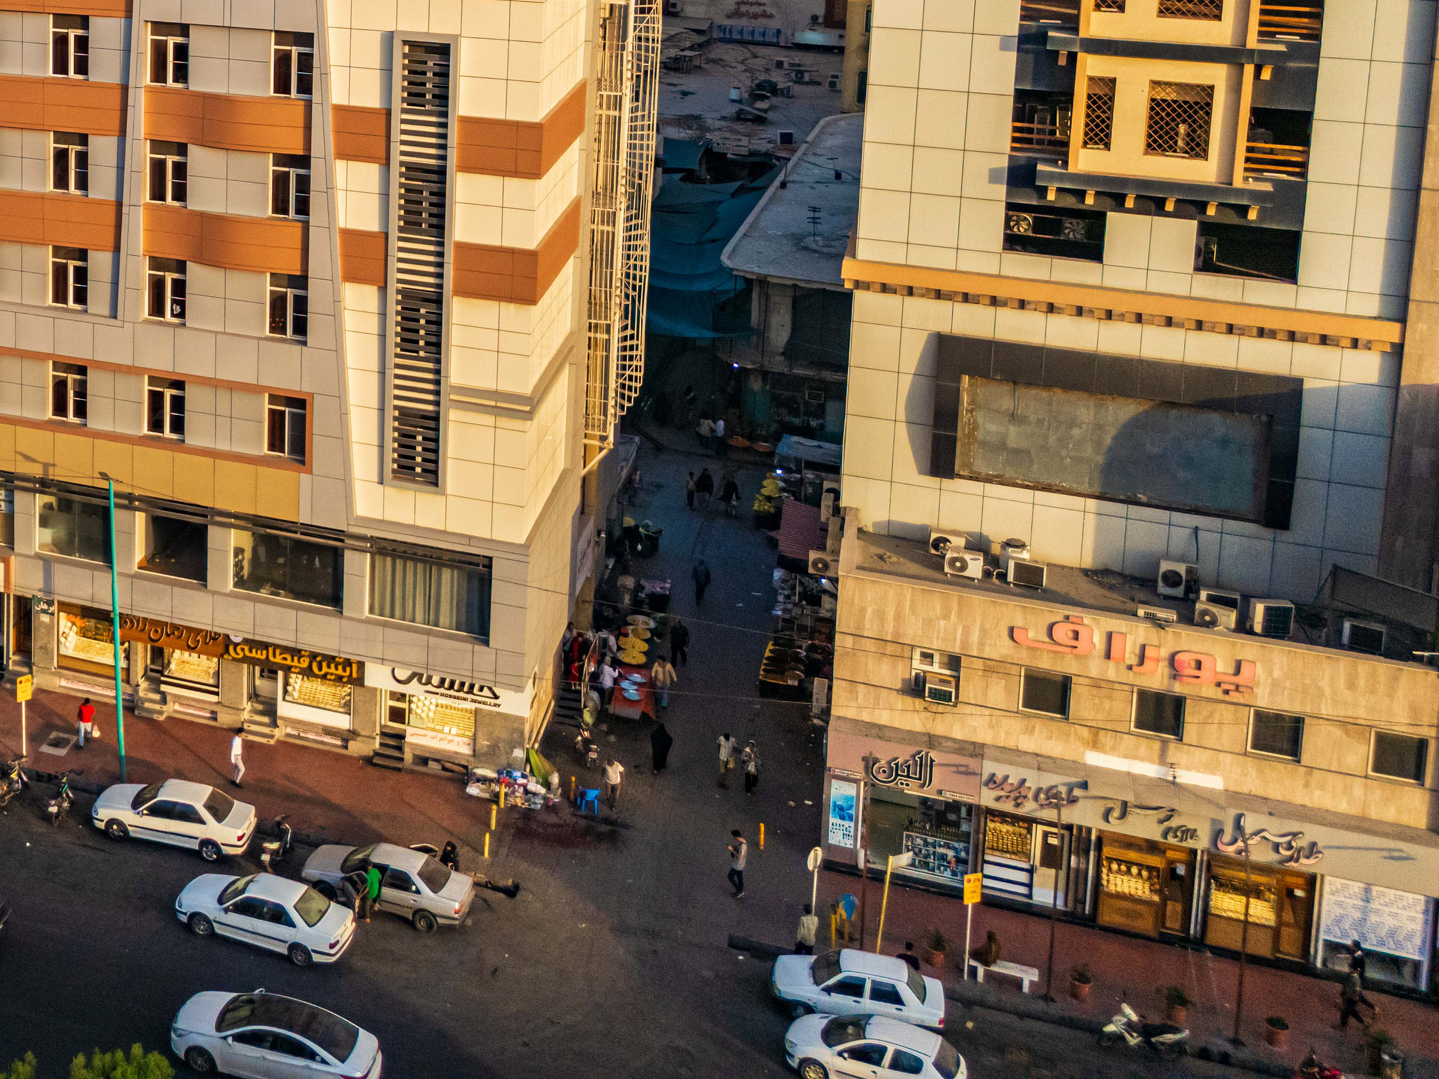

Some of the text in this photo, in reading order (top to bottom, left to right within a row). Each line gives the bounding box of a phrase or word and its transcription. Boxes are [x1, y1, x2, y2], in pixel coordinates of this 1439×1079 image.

[148, 621, 186, 643] رحمان
[186, 629, 223, 650] طلای
[228, 643, 359, 680] آبتین قیطاسی
[1011, 614, 1257, 697] پوراف
[439, 692, 469, 702] HOSSEINI
[871, 750, 937, 790] الین
[1216, 813, 1325, 867] طلای سهیل
